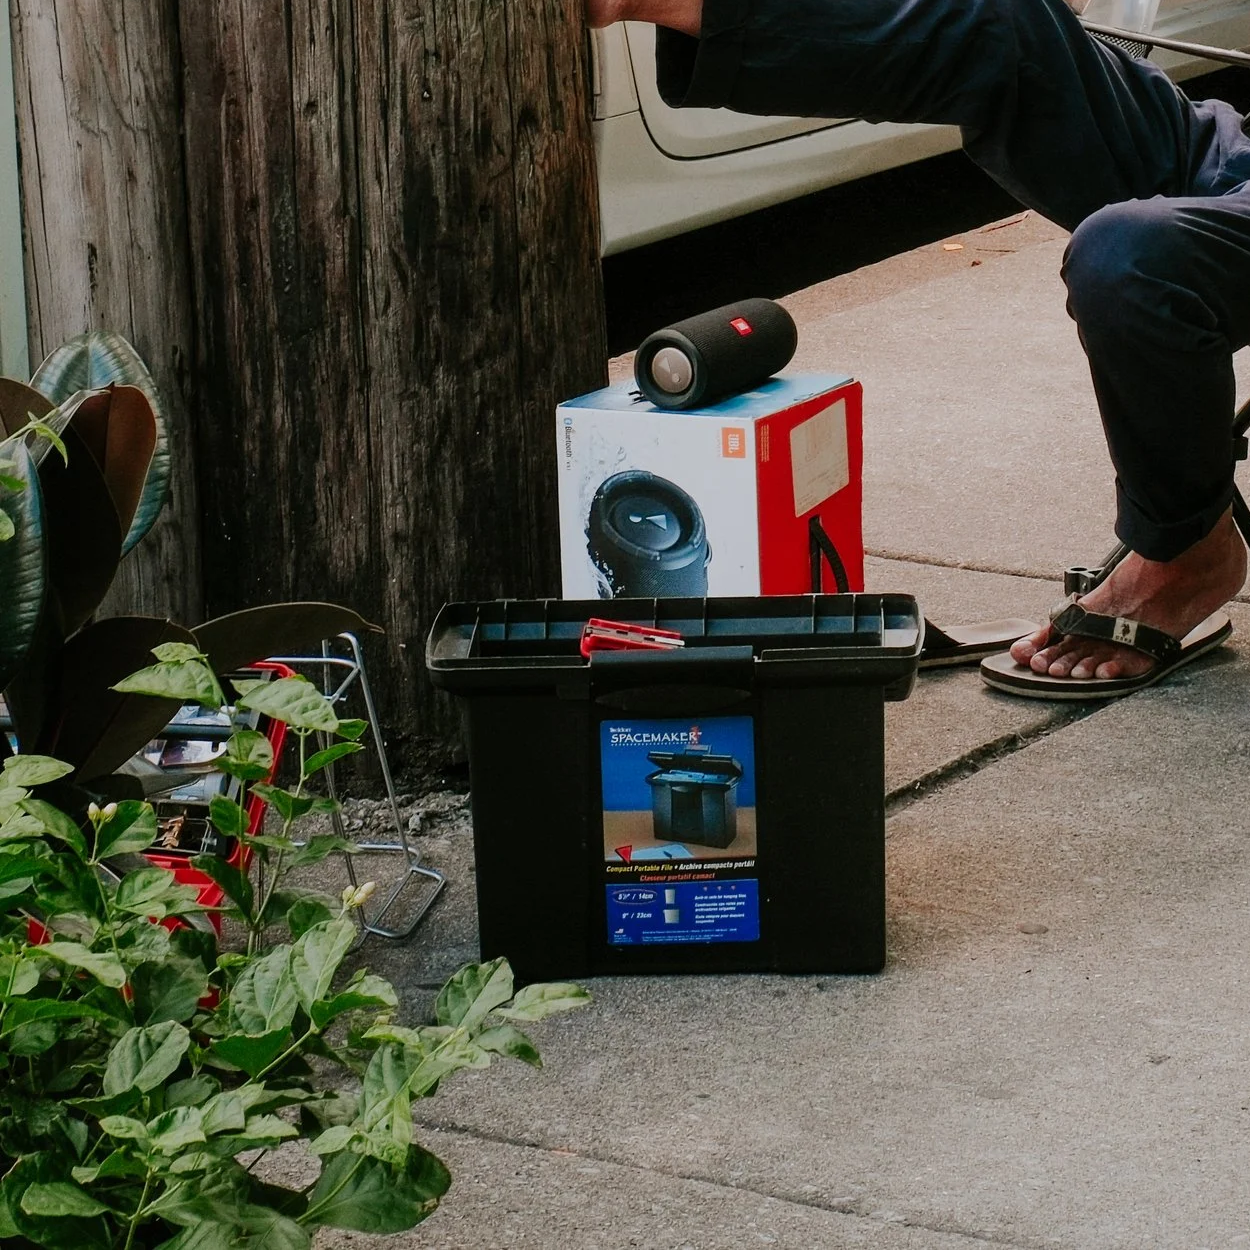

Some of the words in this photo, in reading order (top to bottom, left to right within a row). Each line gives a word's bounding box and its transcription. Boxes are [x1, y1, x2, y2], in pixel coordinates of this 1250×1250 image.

[564, 426, 573, 458] Bluetooth
[606, 865, 633, 873] Compact
[634, 864, 660, 872] Portable
[679, 863, 702, 871] Archivo
[640, 874, 666, 882] Classeur
